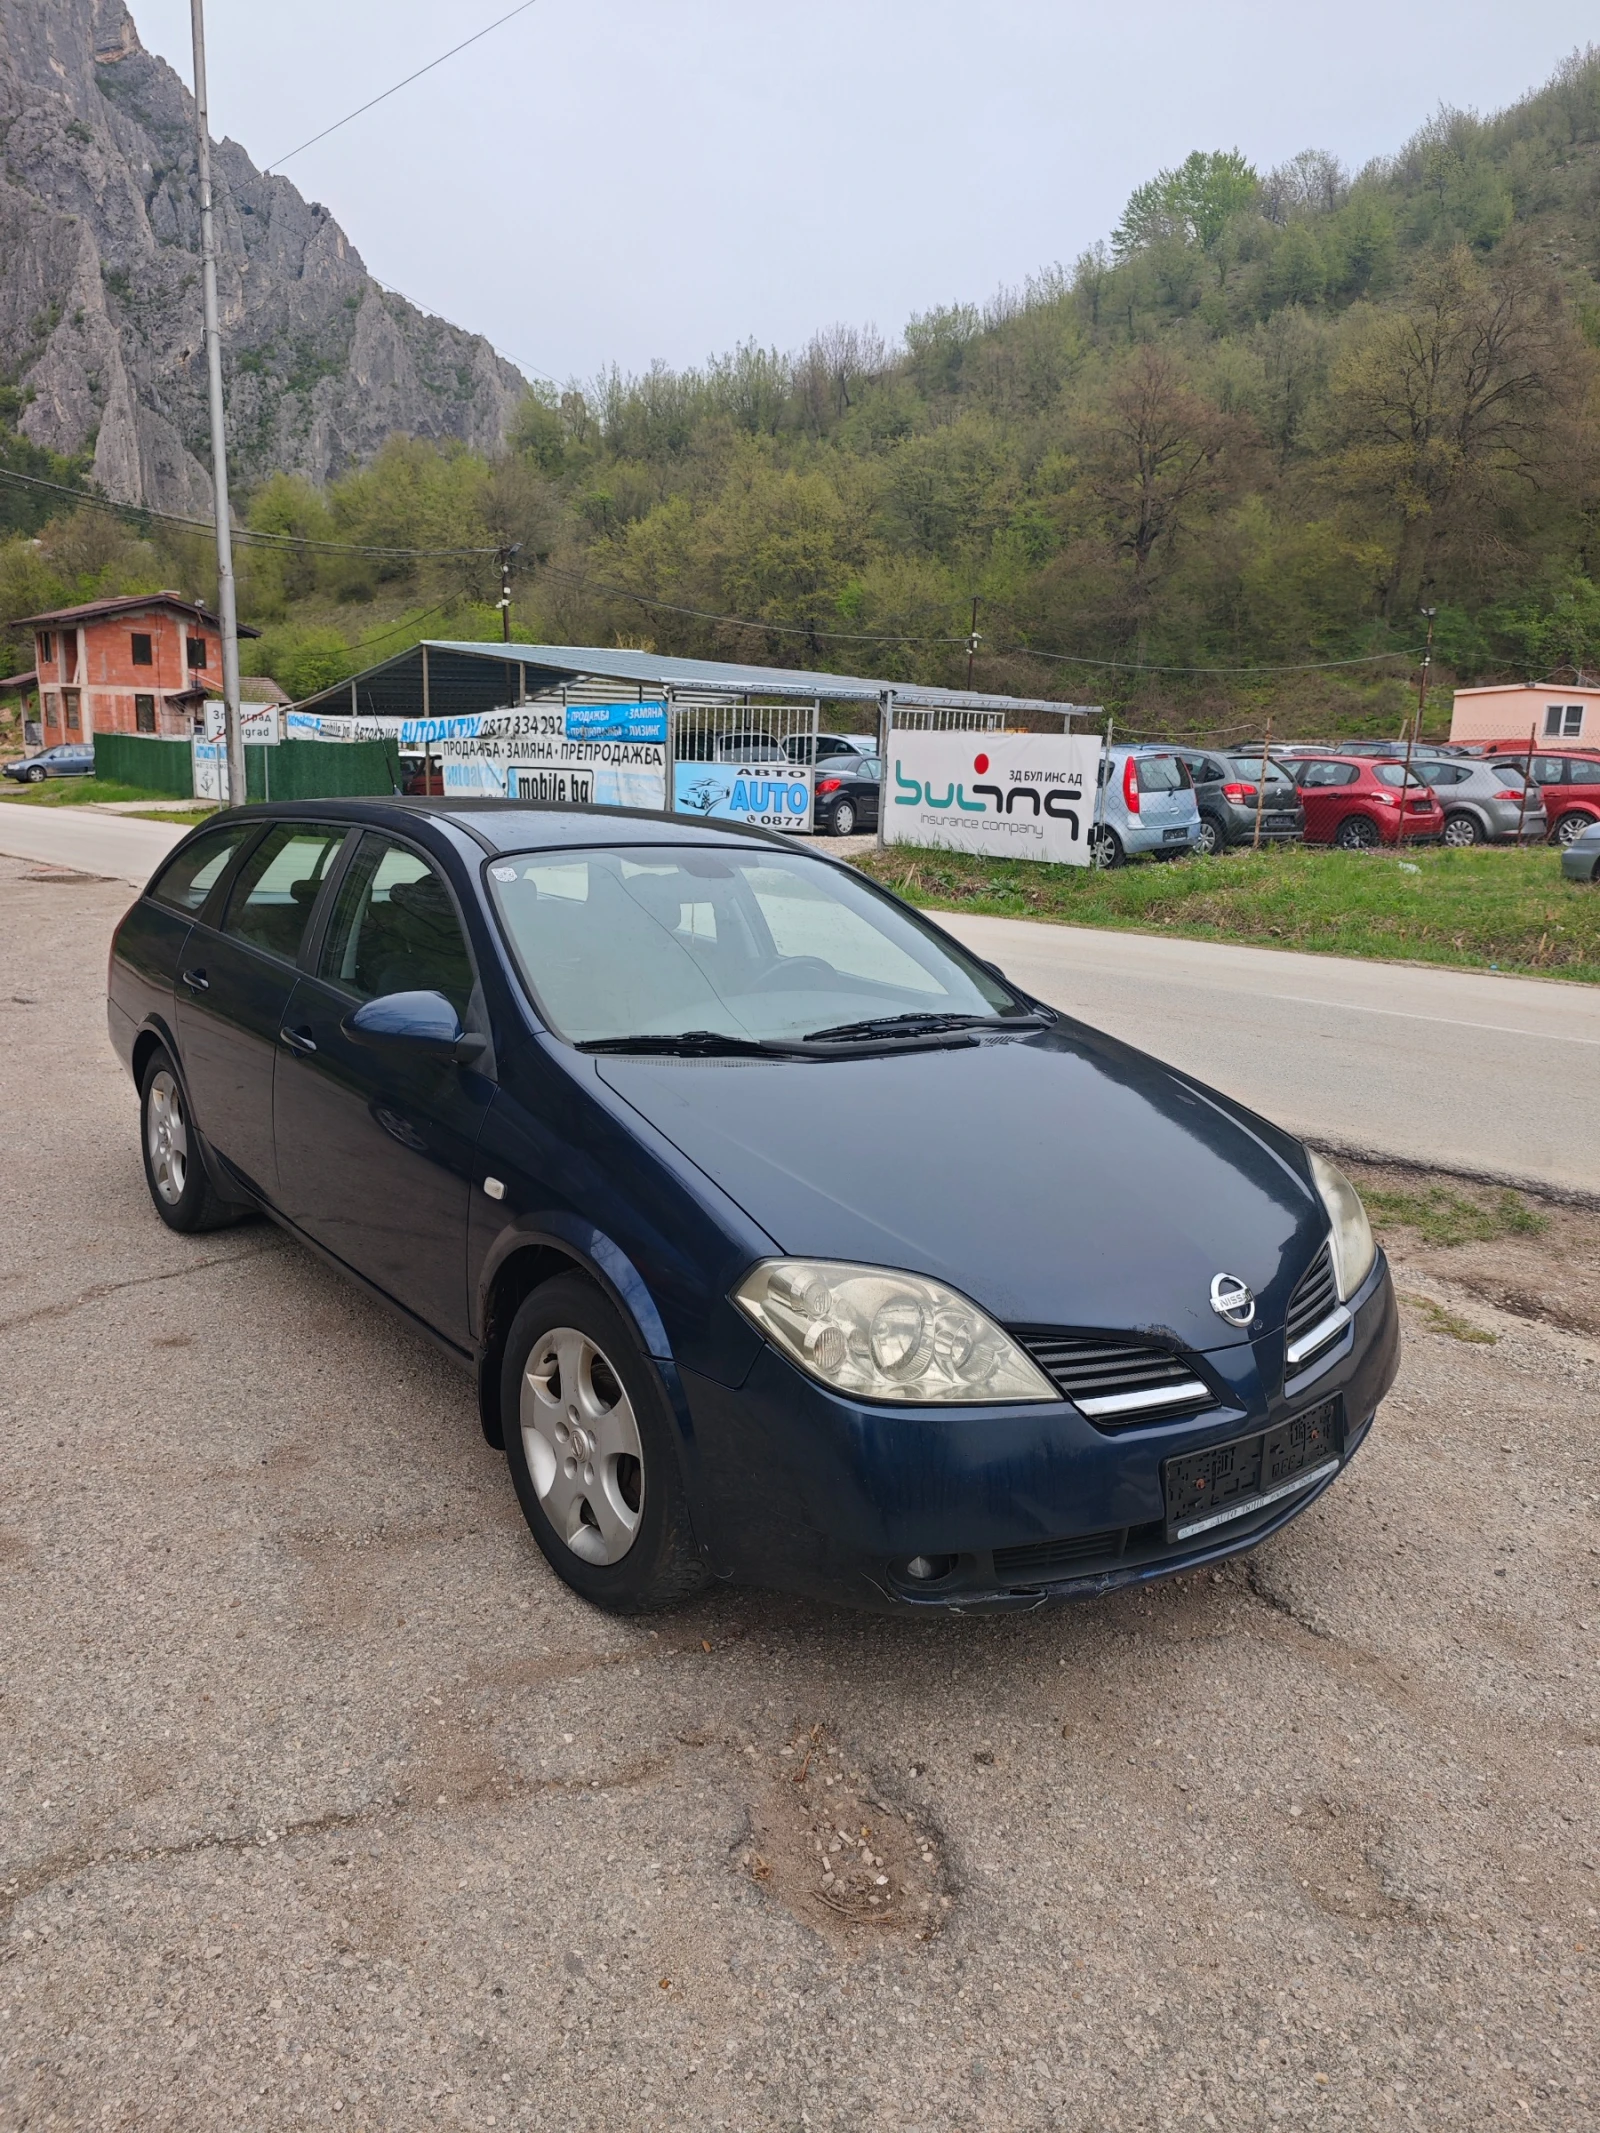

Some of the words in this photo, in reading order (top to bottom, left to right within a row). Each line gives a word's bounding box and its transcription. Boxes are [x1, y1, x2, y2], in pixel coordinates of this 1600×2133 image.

[213, 710, 272, 722] Згиград
[570, 709, 610, 722] ПРОДАЖБА
[628, 706, 663, 719] ЗАМЯНА
[216, 725, 269, 738] Zigrad
[401, 716, 481, 743] AUTOAKTIV
[481, 717, 511, 737] 0877
[514, 715, 538, 735] 334
[541, 715, 564, 735] 292
[628, 724, 661, 737] ЛИЗИНГ
[443, 740, 501, 760] ПРОДАЖБА
[507, 742, 553, 760] ЗАМЯНА
[560, 743, 663, 767] ПРЕПРОДАЖБА
[736, 768, 806, 778] АВТО
[1009, 769, 1022, 783] ЗД
[1024, 770, 1043, 782] БУЛ
[1044, 771, 1067, 784] ИНС
[1068, 773, 1082, 786] АД
[729, 780, 808, 814] AUTO
[760, 815, 804, 827] 0877
[921, 812, 979, 830] insurance
[982, 819, 1044, 840] company
